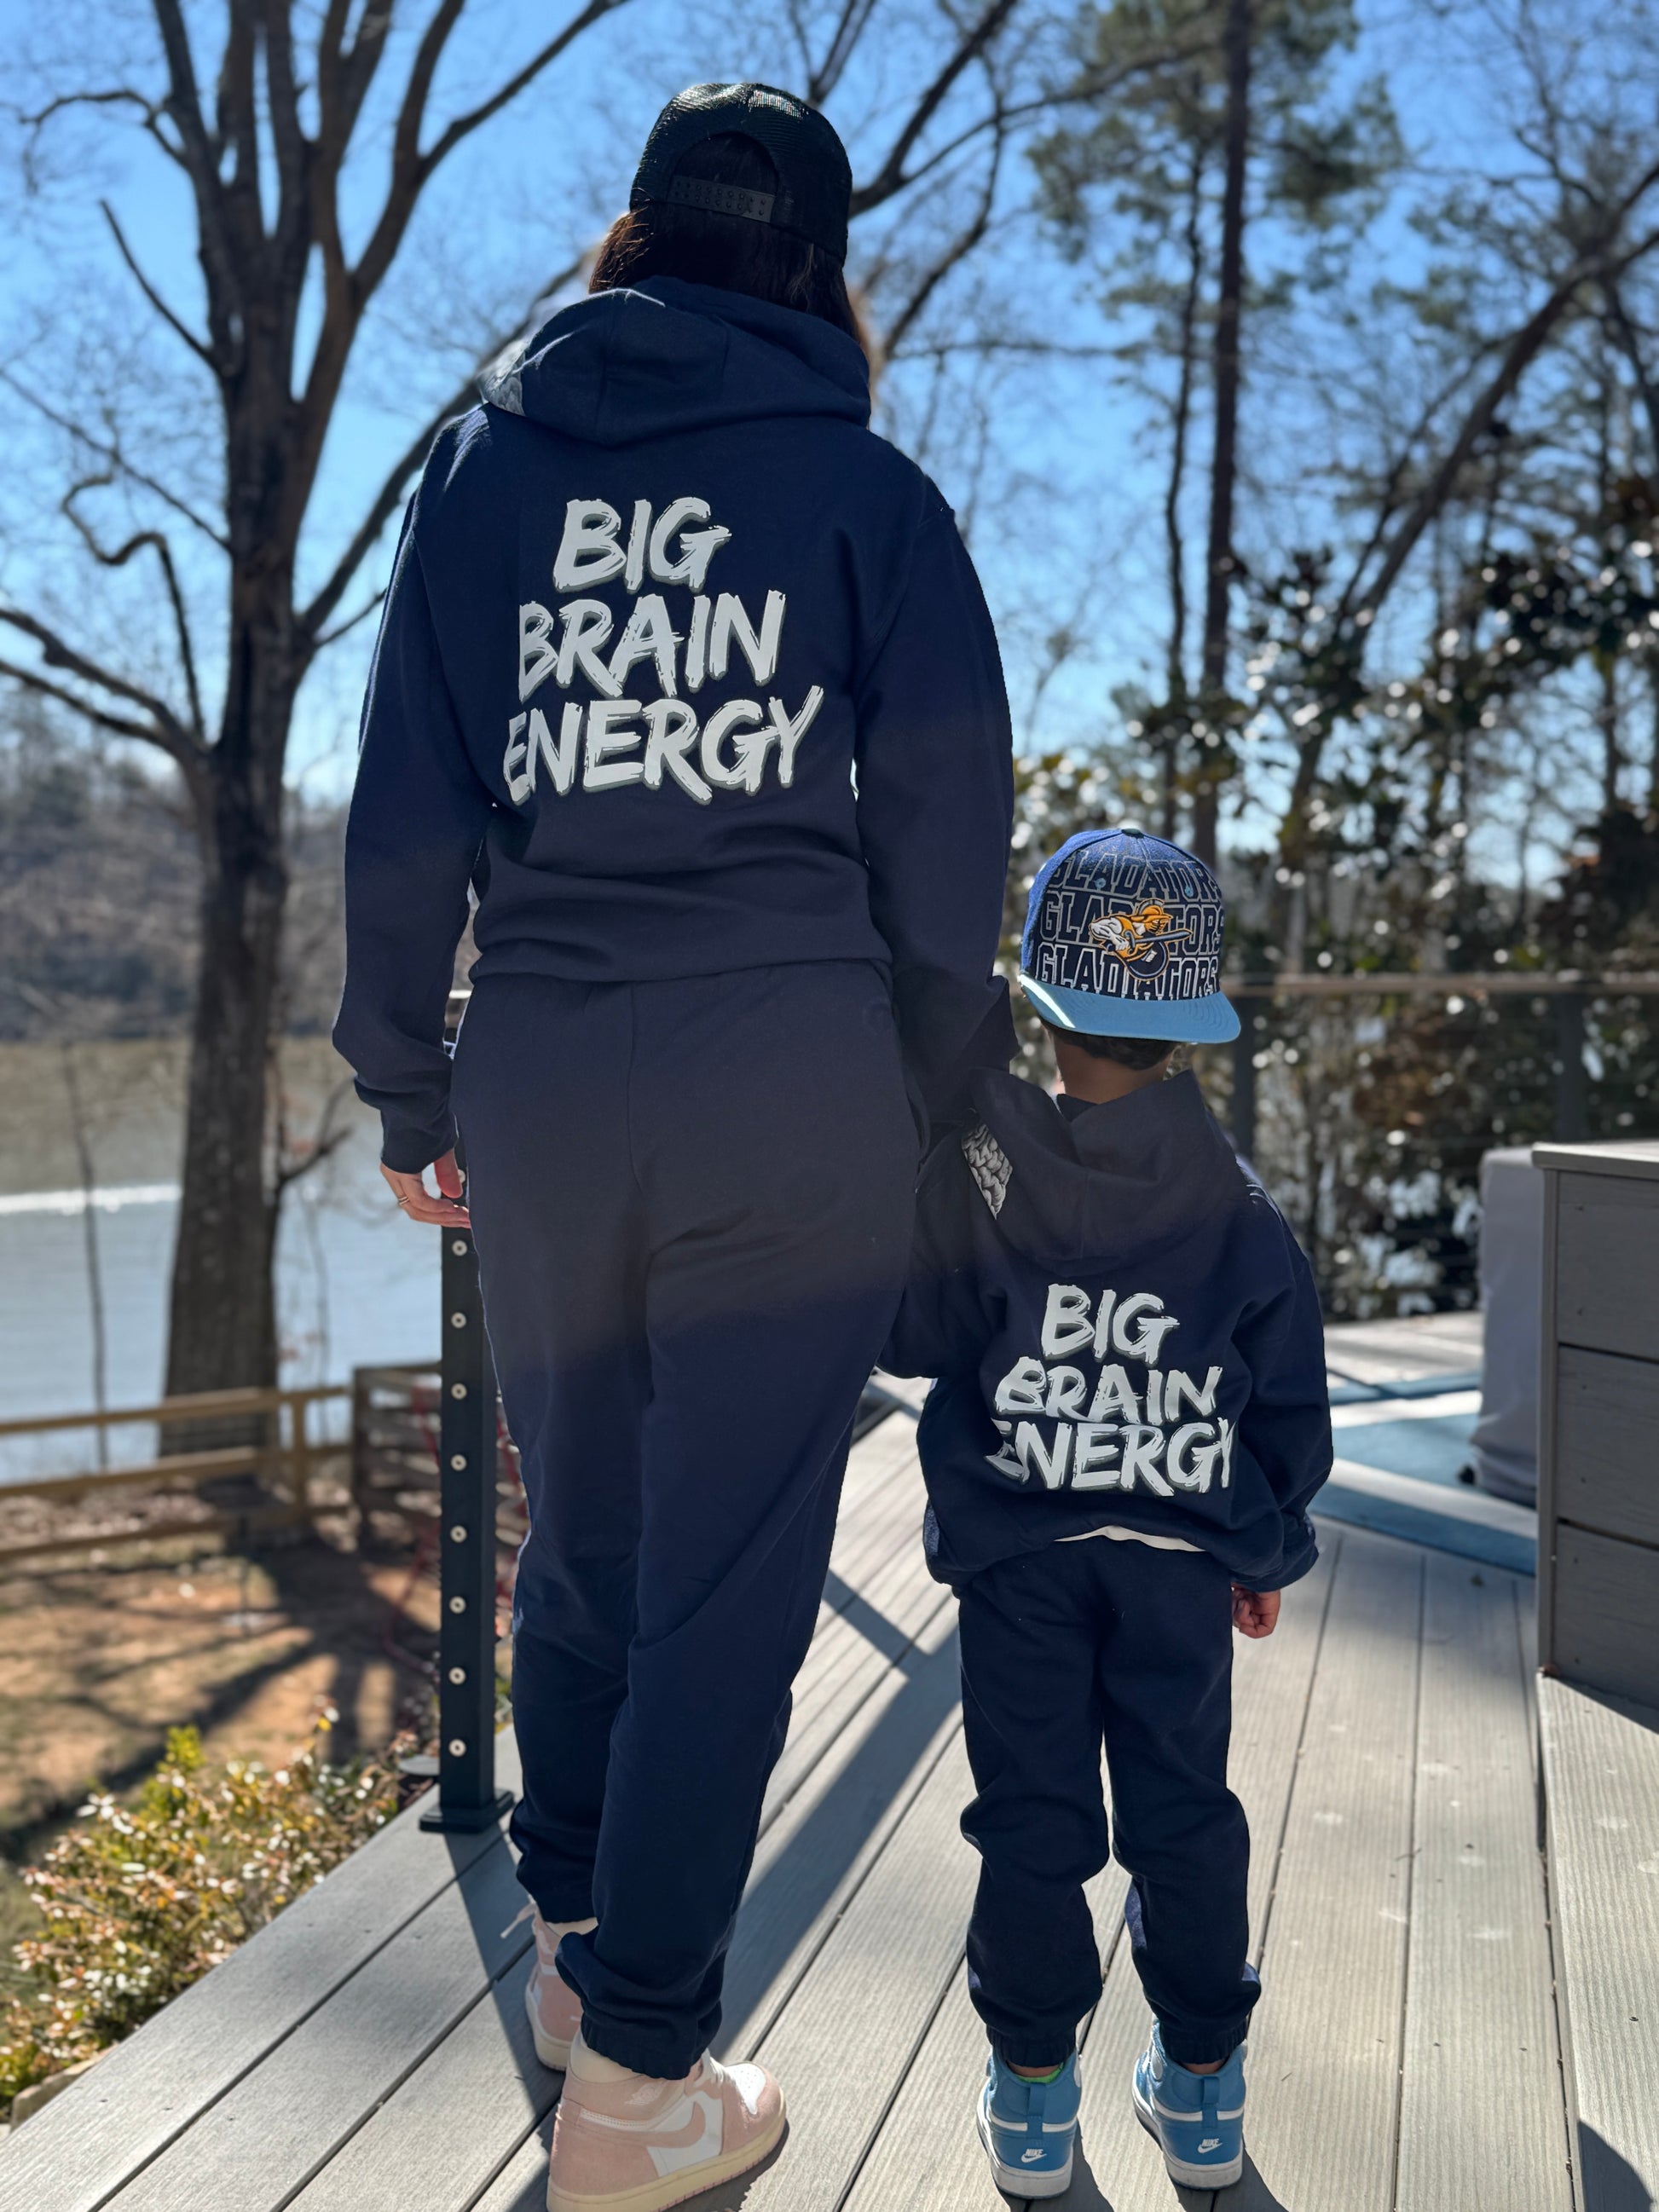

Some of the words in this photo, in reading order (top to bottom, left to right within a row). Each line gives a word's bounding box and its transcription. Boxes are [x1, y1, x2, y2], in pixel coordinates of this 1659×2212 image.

[552, 496, 732, 594] BIG
[518, 590, 786, 703] BRAIN
[503, 685, 824, 805] ENERGY
[1040, 1283, 1180, 1364] BIG
[994, 1356, 1223, 1426] BRAIN
[1025, 2148, 1044, 2157] NIKE
[1201, 2138, 1220, 2147] NIKE
